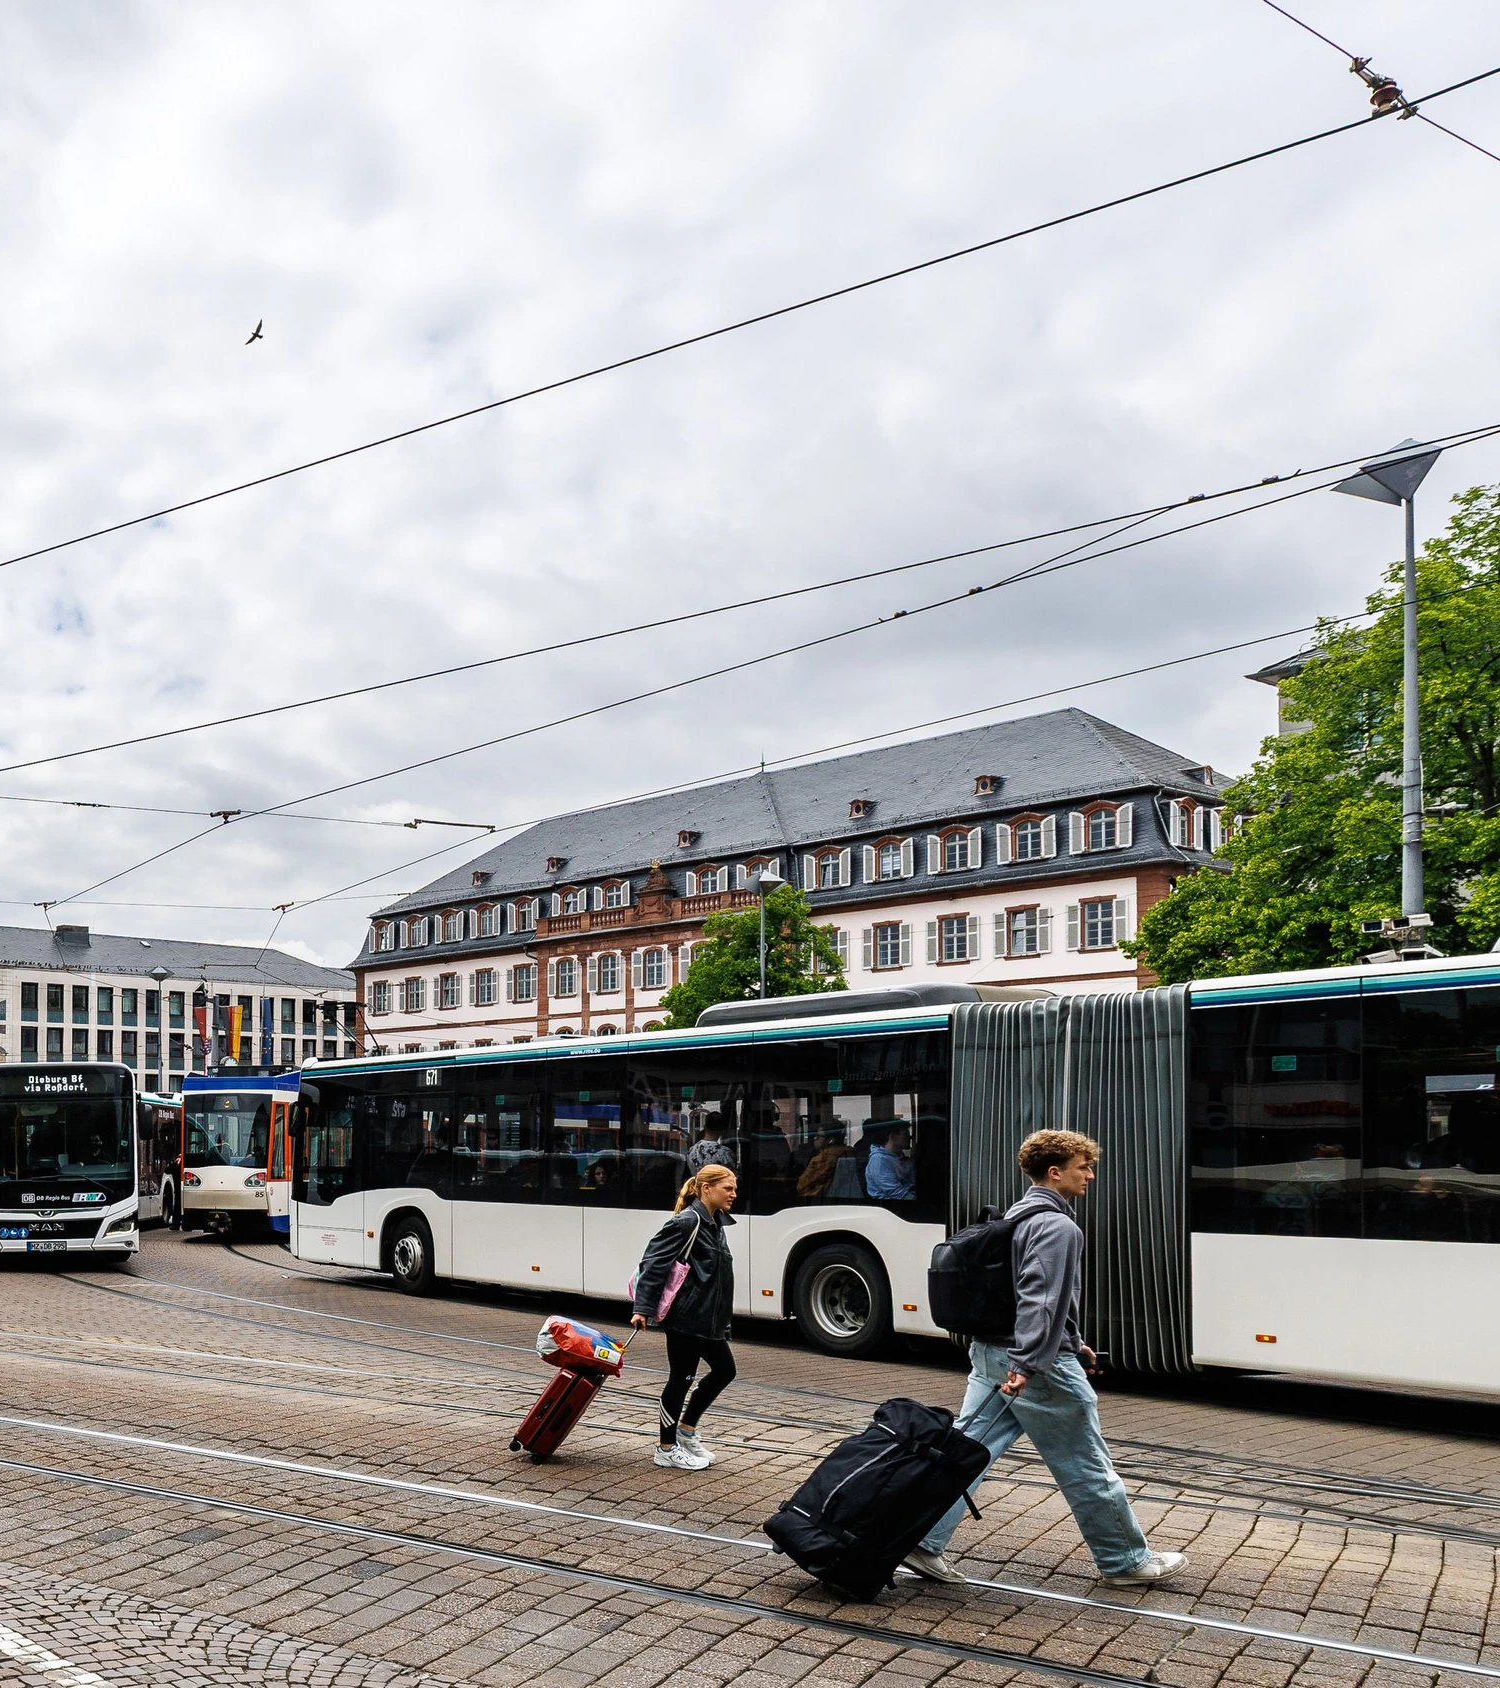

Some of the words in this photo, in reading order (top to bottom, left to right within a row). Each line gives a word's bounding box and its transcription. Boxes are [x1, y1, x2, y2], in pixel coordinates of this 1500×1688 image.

[28, 1075, 67, 1085] Dieburg
[71, 1074, 83, 1083] Bf
[425, 1069, 438, 1086] 671
[24, 1084, 41, 1092] via
[44, 1083, 88, 1093] Roßdorf,
[28, 1223, 65, 1232] MAN
